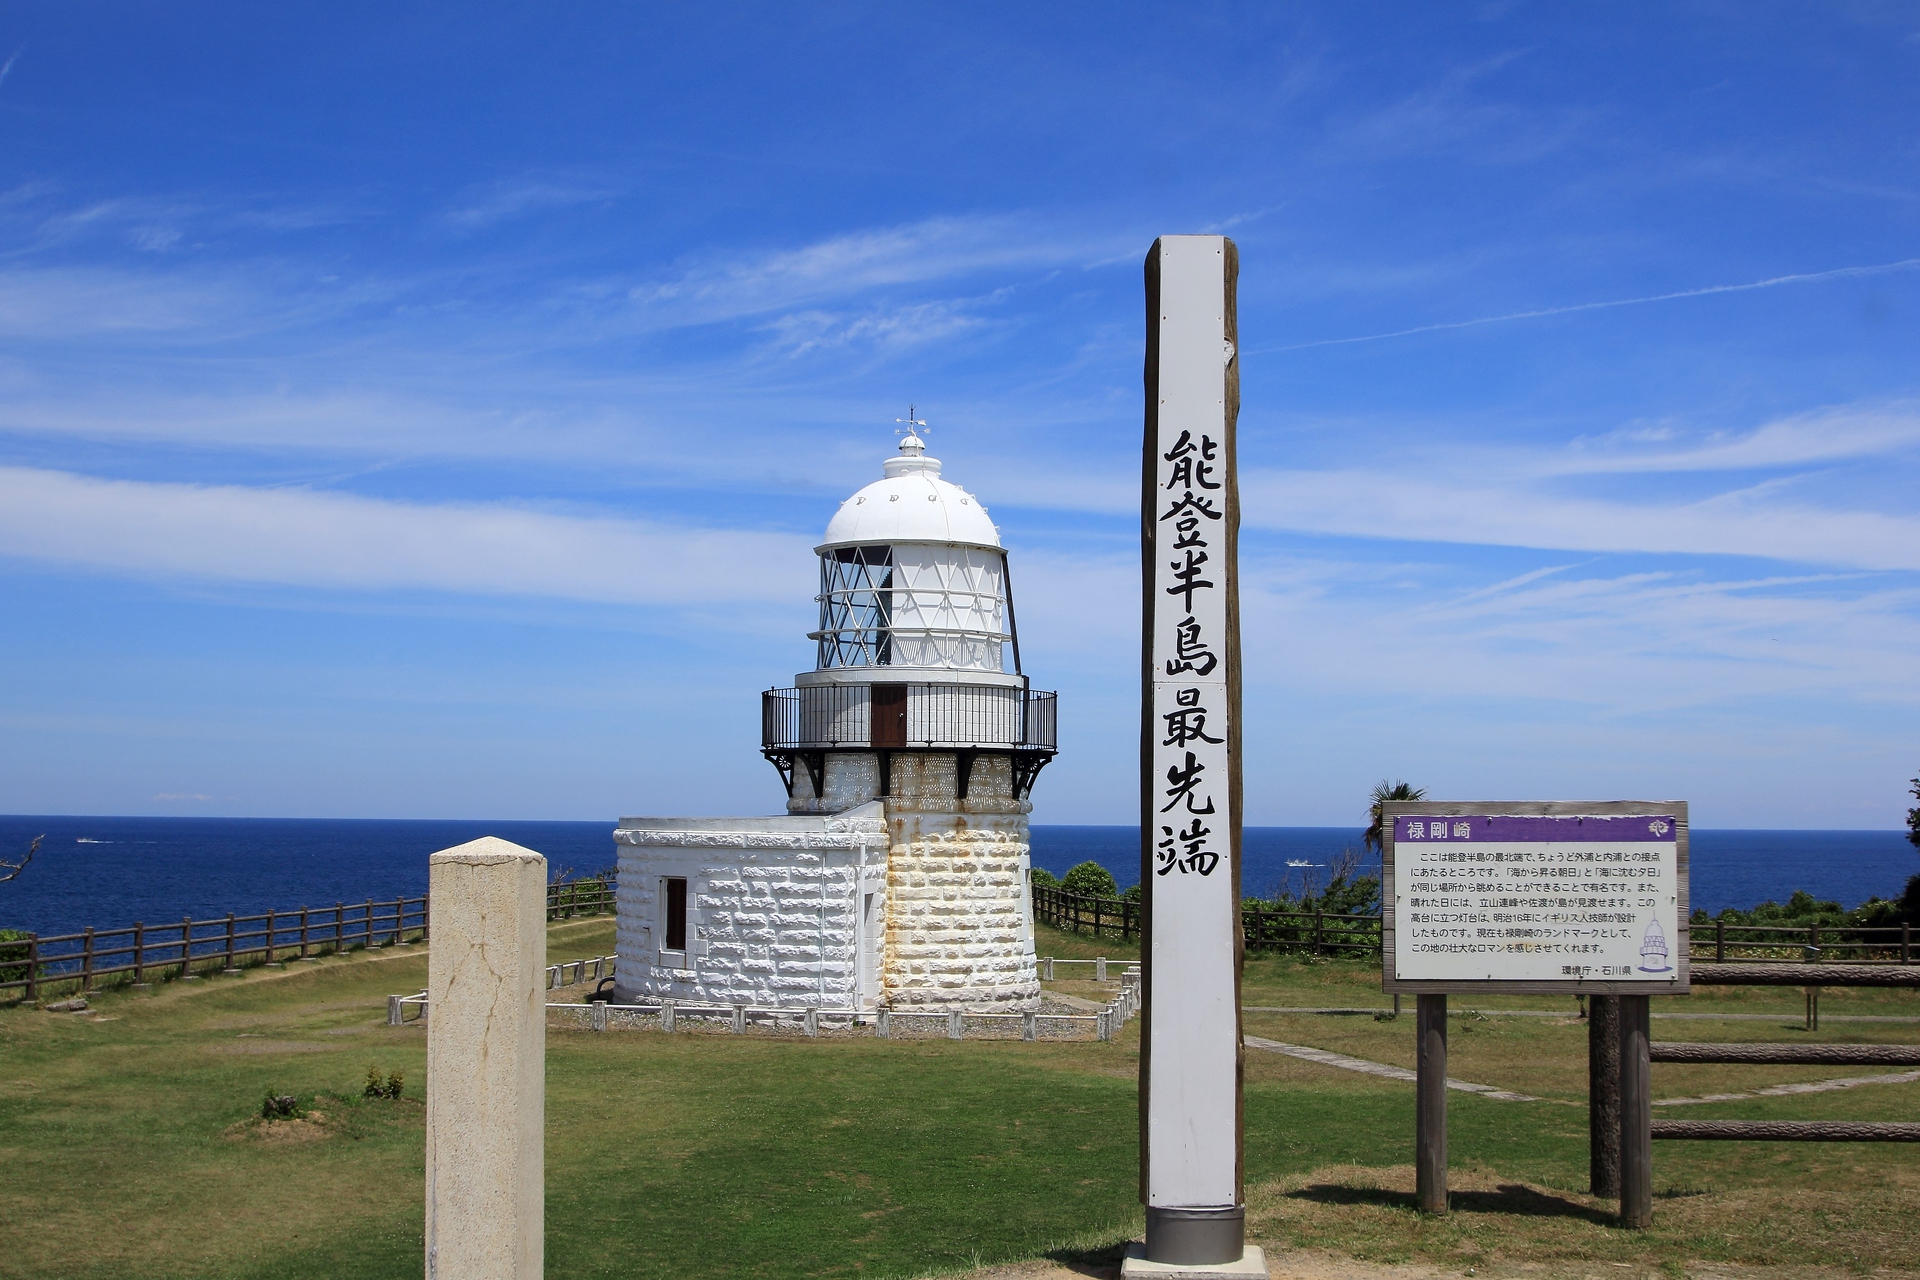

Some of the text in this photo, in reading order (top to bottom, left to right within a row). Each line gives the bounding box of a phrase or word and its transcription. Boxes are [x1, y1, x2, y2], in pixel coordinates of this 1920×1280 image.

[1156, 429, 1226, 877] 能登半島最先端
[1407, 821, 1471, 839] 禄剛崎
[1420, 852, 1661, 863] ここは能登半島の最北端で、ちょうど外浦と内浦との接点
[1410, 882, 1660, 893] が同じ場所から眺めることができることで有名です。また、
[1410, 897, 1656, 908] 晴れた日には、立山連峰や佐渡が島が見渡せます。この
[1410, 912, 1636, 923] 高台に立つ灯台は、明治16年にイギリス人技師が設計
[1411, 928, 1633, 939] したものです。現在も禄剛崎のランドマークとして、
[1411, 943, 1605, 954] この地の壮大なロマンを感じさせてくれます。
[1561, 965, 1632, 976] 環境庁・石川県
